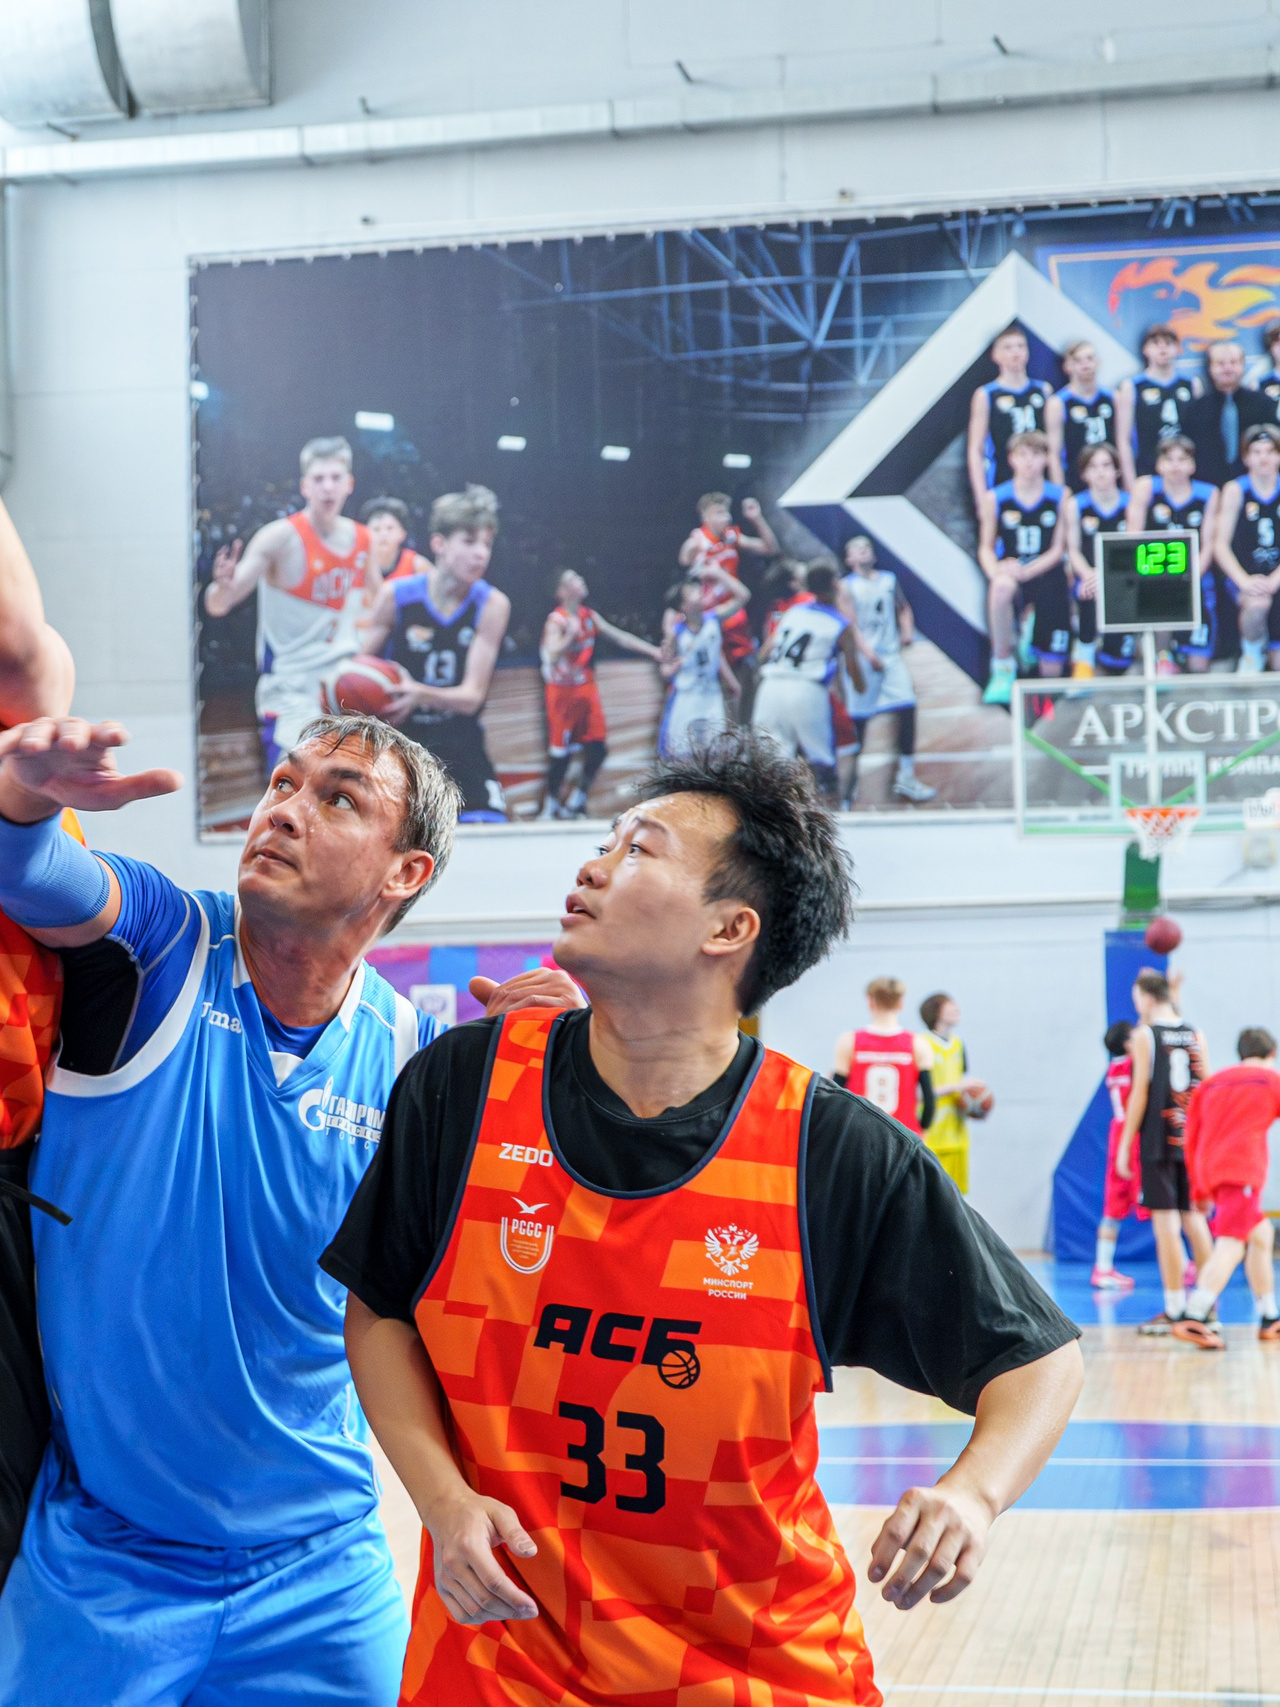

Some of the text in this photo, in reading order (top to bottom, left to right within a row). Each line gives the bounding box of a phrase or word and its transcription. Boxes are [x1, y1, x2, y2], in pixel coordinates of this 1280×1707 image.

[201, 1001, 242, 1034] Jma
[865, 1064, 900, 1116] 8
[325, 1127, 372, 1150] ТОМС
[498, 1142, 554, 1167] ZEDO
[703, 1276, 754, 1290] МИНСПОРТ
[708, 1288, 747, 1300] РОССИИ
[558, 1400, 666, 1515] 33
